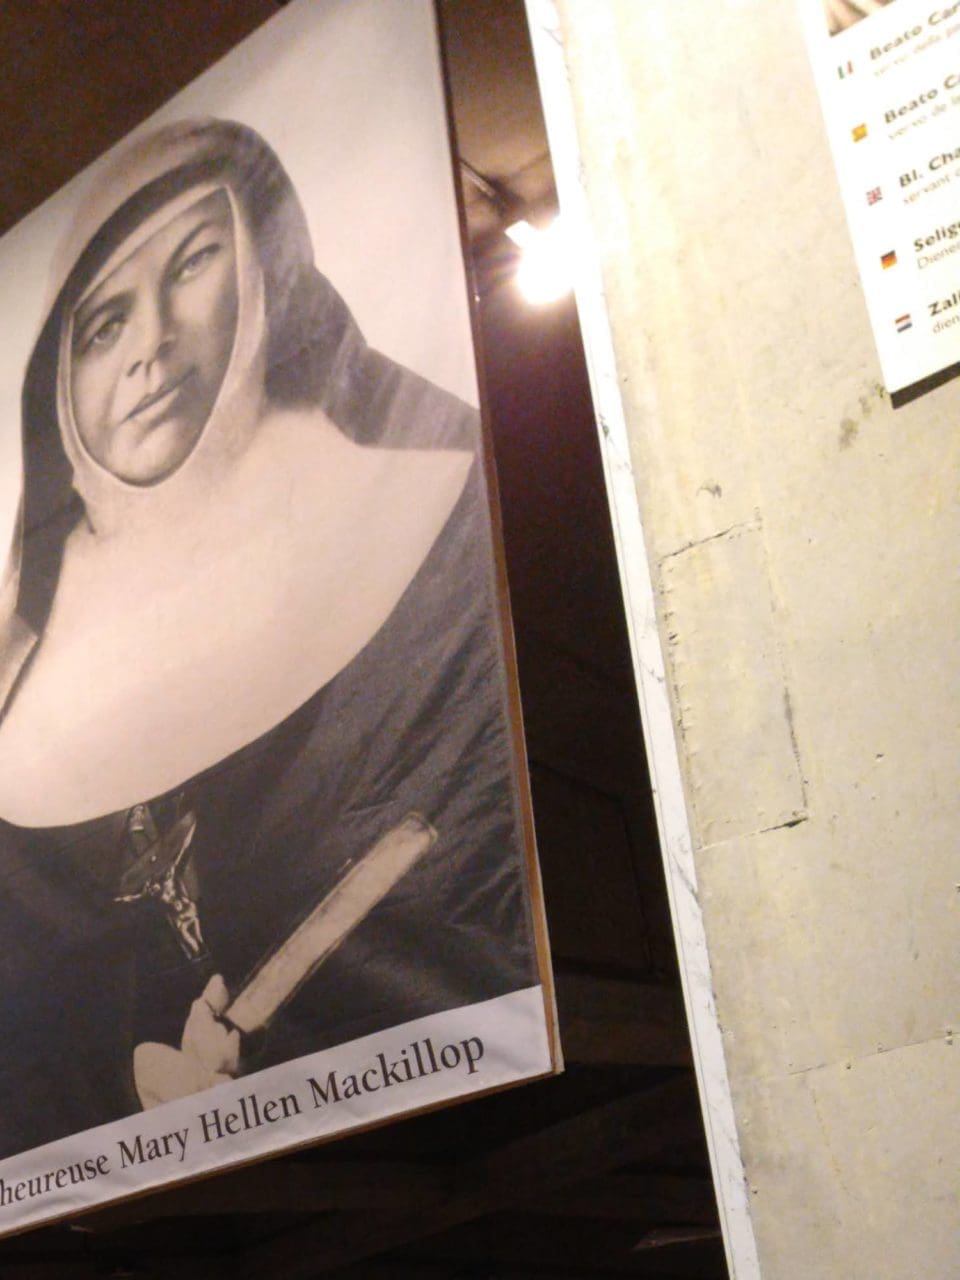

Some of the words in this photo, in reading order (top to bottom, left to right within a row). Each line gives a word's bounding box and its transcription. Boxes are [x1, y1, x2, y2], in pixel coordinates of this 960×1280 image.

[870, 25, 922, 60] Beato
[884, 88, 938, 124] Beato
[899, 168, 924, 188] Bl.
[117, 1126, 190, 1169] Mary
[198, 1092, 300, 1144] Hellen
[307, 1031, 487, 1110] Mackillop
